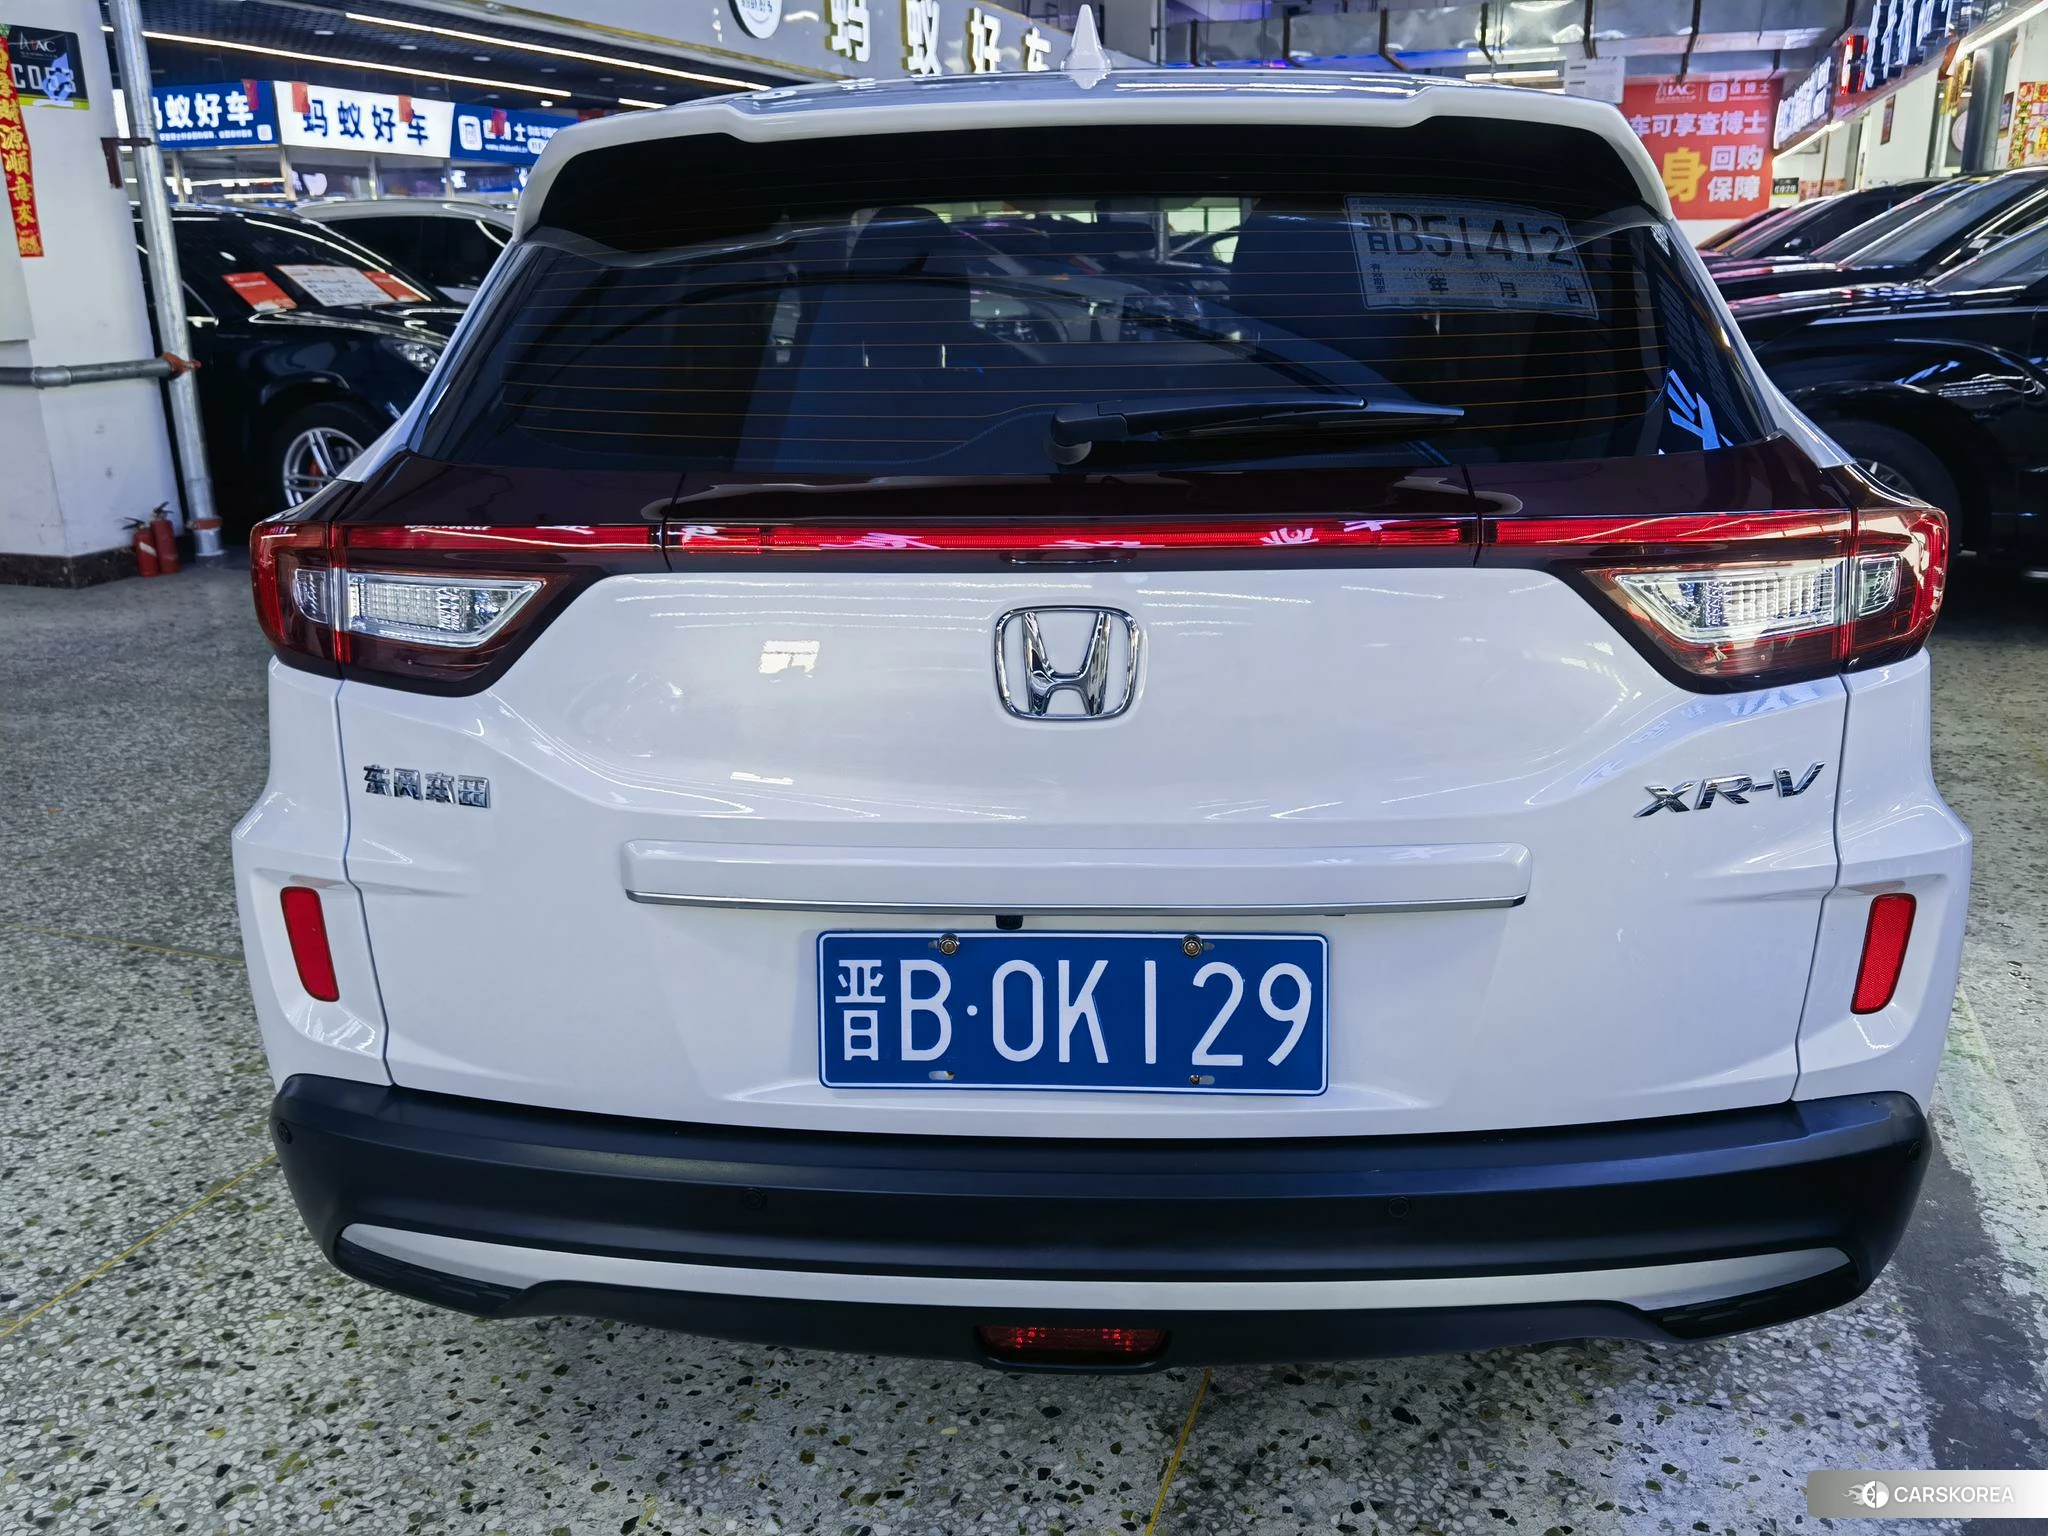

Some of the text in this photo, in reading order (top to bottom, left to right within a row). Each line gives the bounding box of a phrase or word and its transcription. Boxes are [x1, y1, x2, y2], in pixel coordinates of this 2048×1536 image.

[1709, 145, 1765, 172] 回购
[1707, 175, 1761, 203] 保障
[363, 764, 492, 810] 东风本田
[1633, 761, 1826, 818] XR-V
